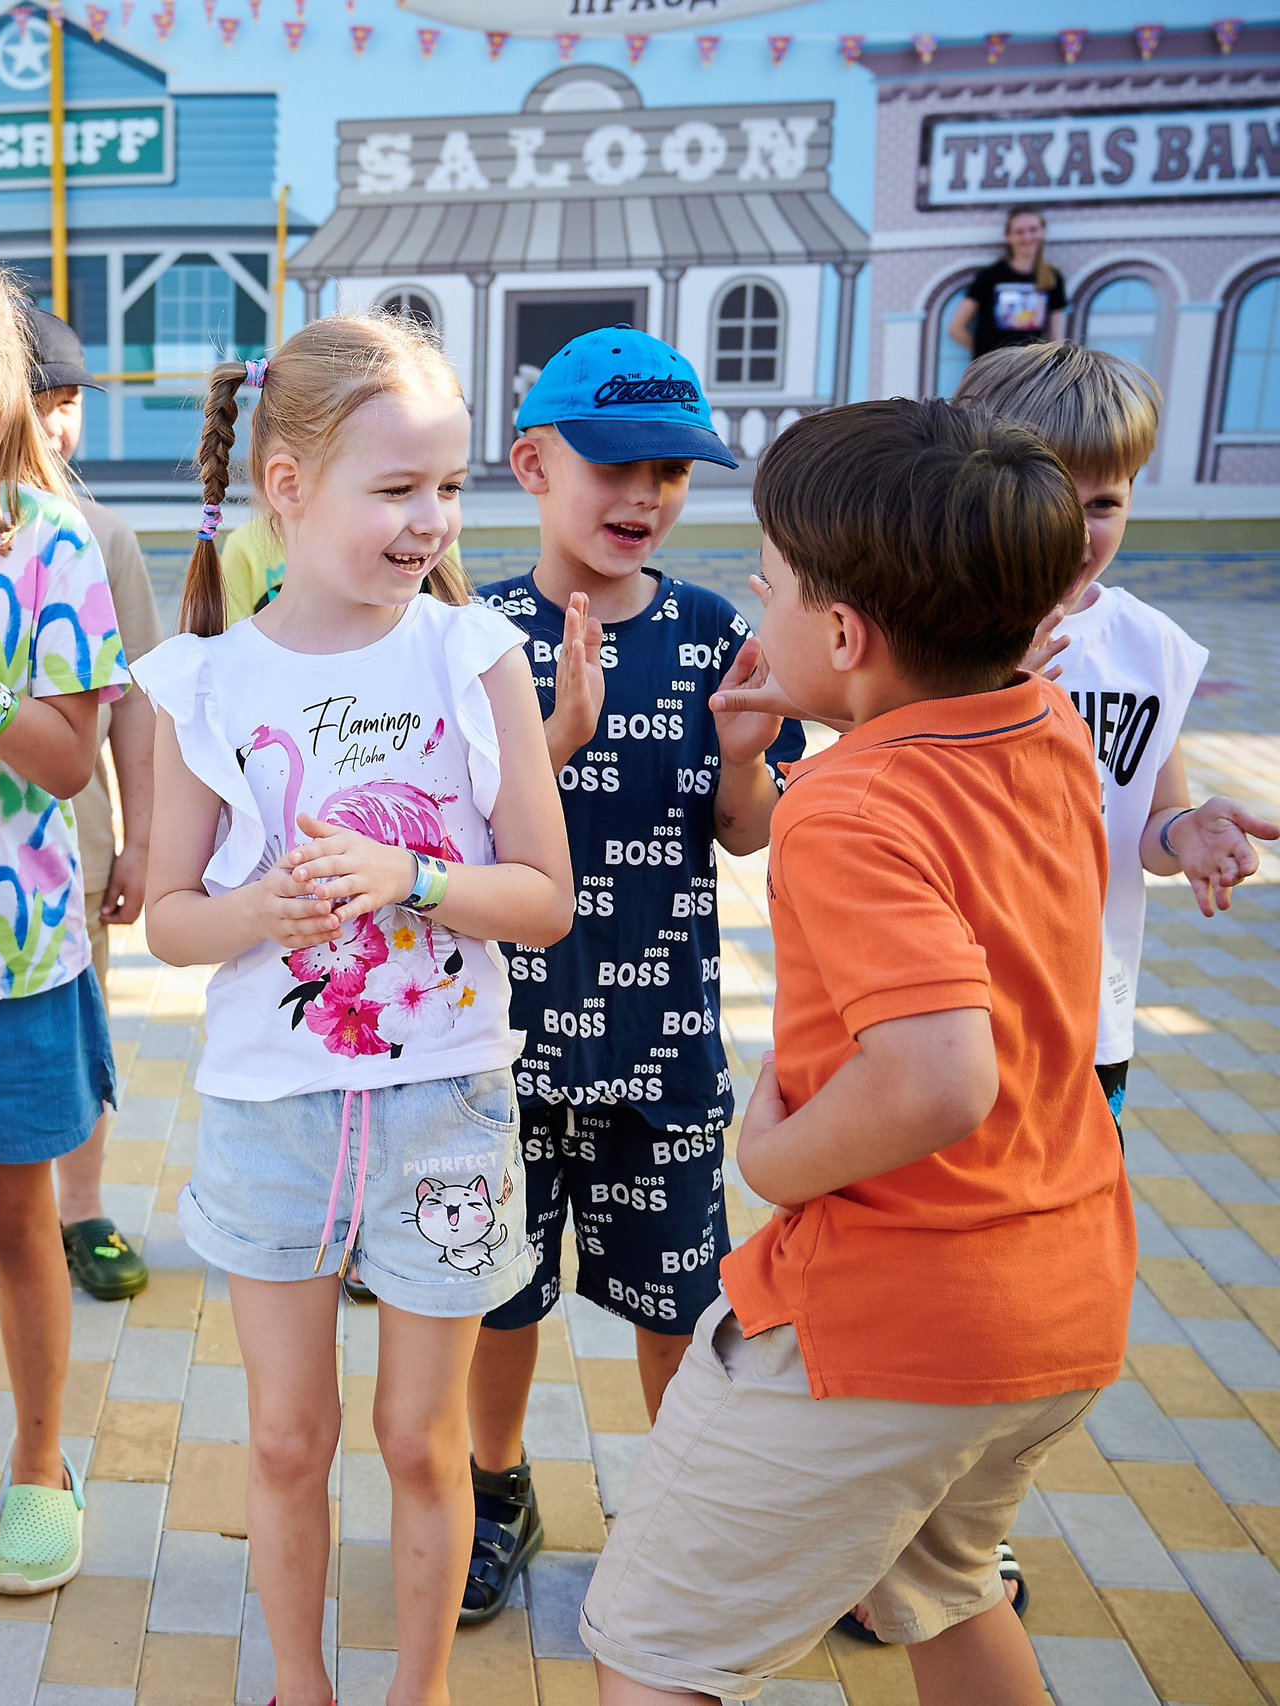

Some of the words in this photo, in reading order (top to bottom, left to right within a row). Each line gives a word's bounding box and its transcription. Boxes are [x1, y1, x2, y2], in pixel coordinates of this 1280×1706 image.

[356, 117, 818, 194] SALOON
[943, 127, 1137, 190] TEXAS
[532, 677, 554, 687] OSS
[671, 680, 696, 692] BOSS
[657, 698, 683, 710] BOSS
[303, 695, 421, 757] Flamingo
[607, 714, 684, 740] BOSS
[334, 743, 386, 776] Aloha
[586, 751, 618, 762] BOSS
[704, 755, 719, 766] BO
[558, 765, 620, 792] OSS
[677, 768, 712, 795] BOS
[653, 826, 682, 837] BOSS
[605, 839, 683, 866] BOSS
[582, 875, 614, 887] BOSS
[658, 930, 688, 942] BOSS
[644, 947, 670, 959] BOSS
[598, 961, 670, 988] BOSS
[583, 997, 605, 1008] BOSS
[543, 1008, 606, 1039] BOSS
[537, 1043, 562, 1058] BOSS
[650, 1047, 679, 1058] BOSS
[521, 1058, 550, 1071] BOSS
[633, 1064, 662, 1075] BOSS
[707, 1106, 724, 1119] BOSS
[573, 1130, 595, 1140] OSS
[652, 1132, 716, 1165] BOSS
[403, 1151, 499, 1176] PURRFECT
[634, 1176, 665, 1186] BOSS
[590, 1183, 668, 1212] BOSS
[538, 1209, 559, 1223] BOSS
[661, 1236, 715, 1274] BOSS
[644, 1281, 674, 1294] BOSS
[608, 1277, 678, 1321] BOSS
